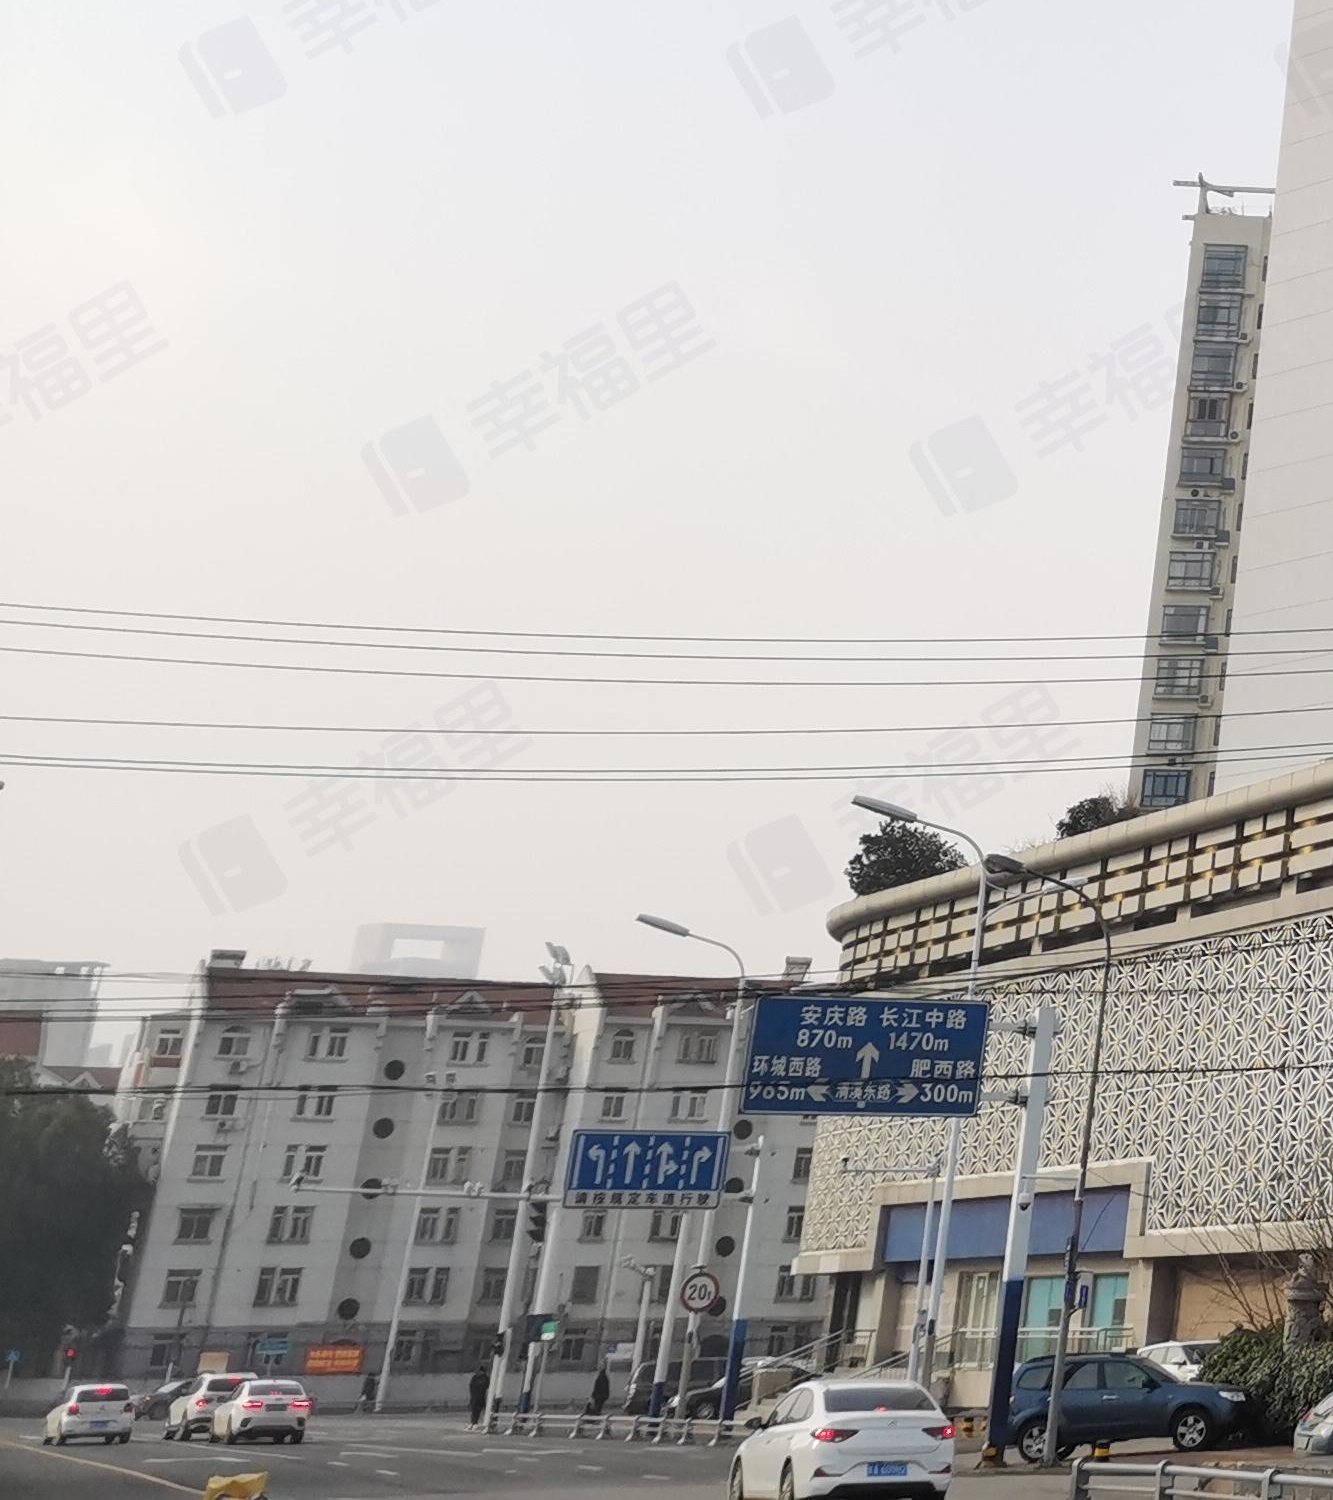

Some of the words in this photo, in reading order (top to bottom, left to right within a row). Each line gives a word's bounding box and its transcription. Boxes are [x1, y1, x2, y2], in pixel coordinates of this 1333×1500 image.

[800, 1004, 868, 1027] 安庆路
[879, 1006, 968, 1030] 长江中路
[796, 1029, 853, 1049] 870m
[888, 1031, 950, 1052] 1470m
[751, 1055, 823, 1078] 环城西路
[910, 1058, 977, 1080] 肥西路
[749, 1079, 806, 1101] 965m
[919, 1083, 974, 1103] 300m
[574, 1191, 710, 1206] 请按规定车道行驶
